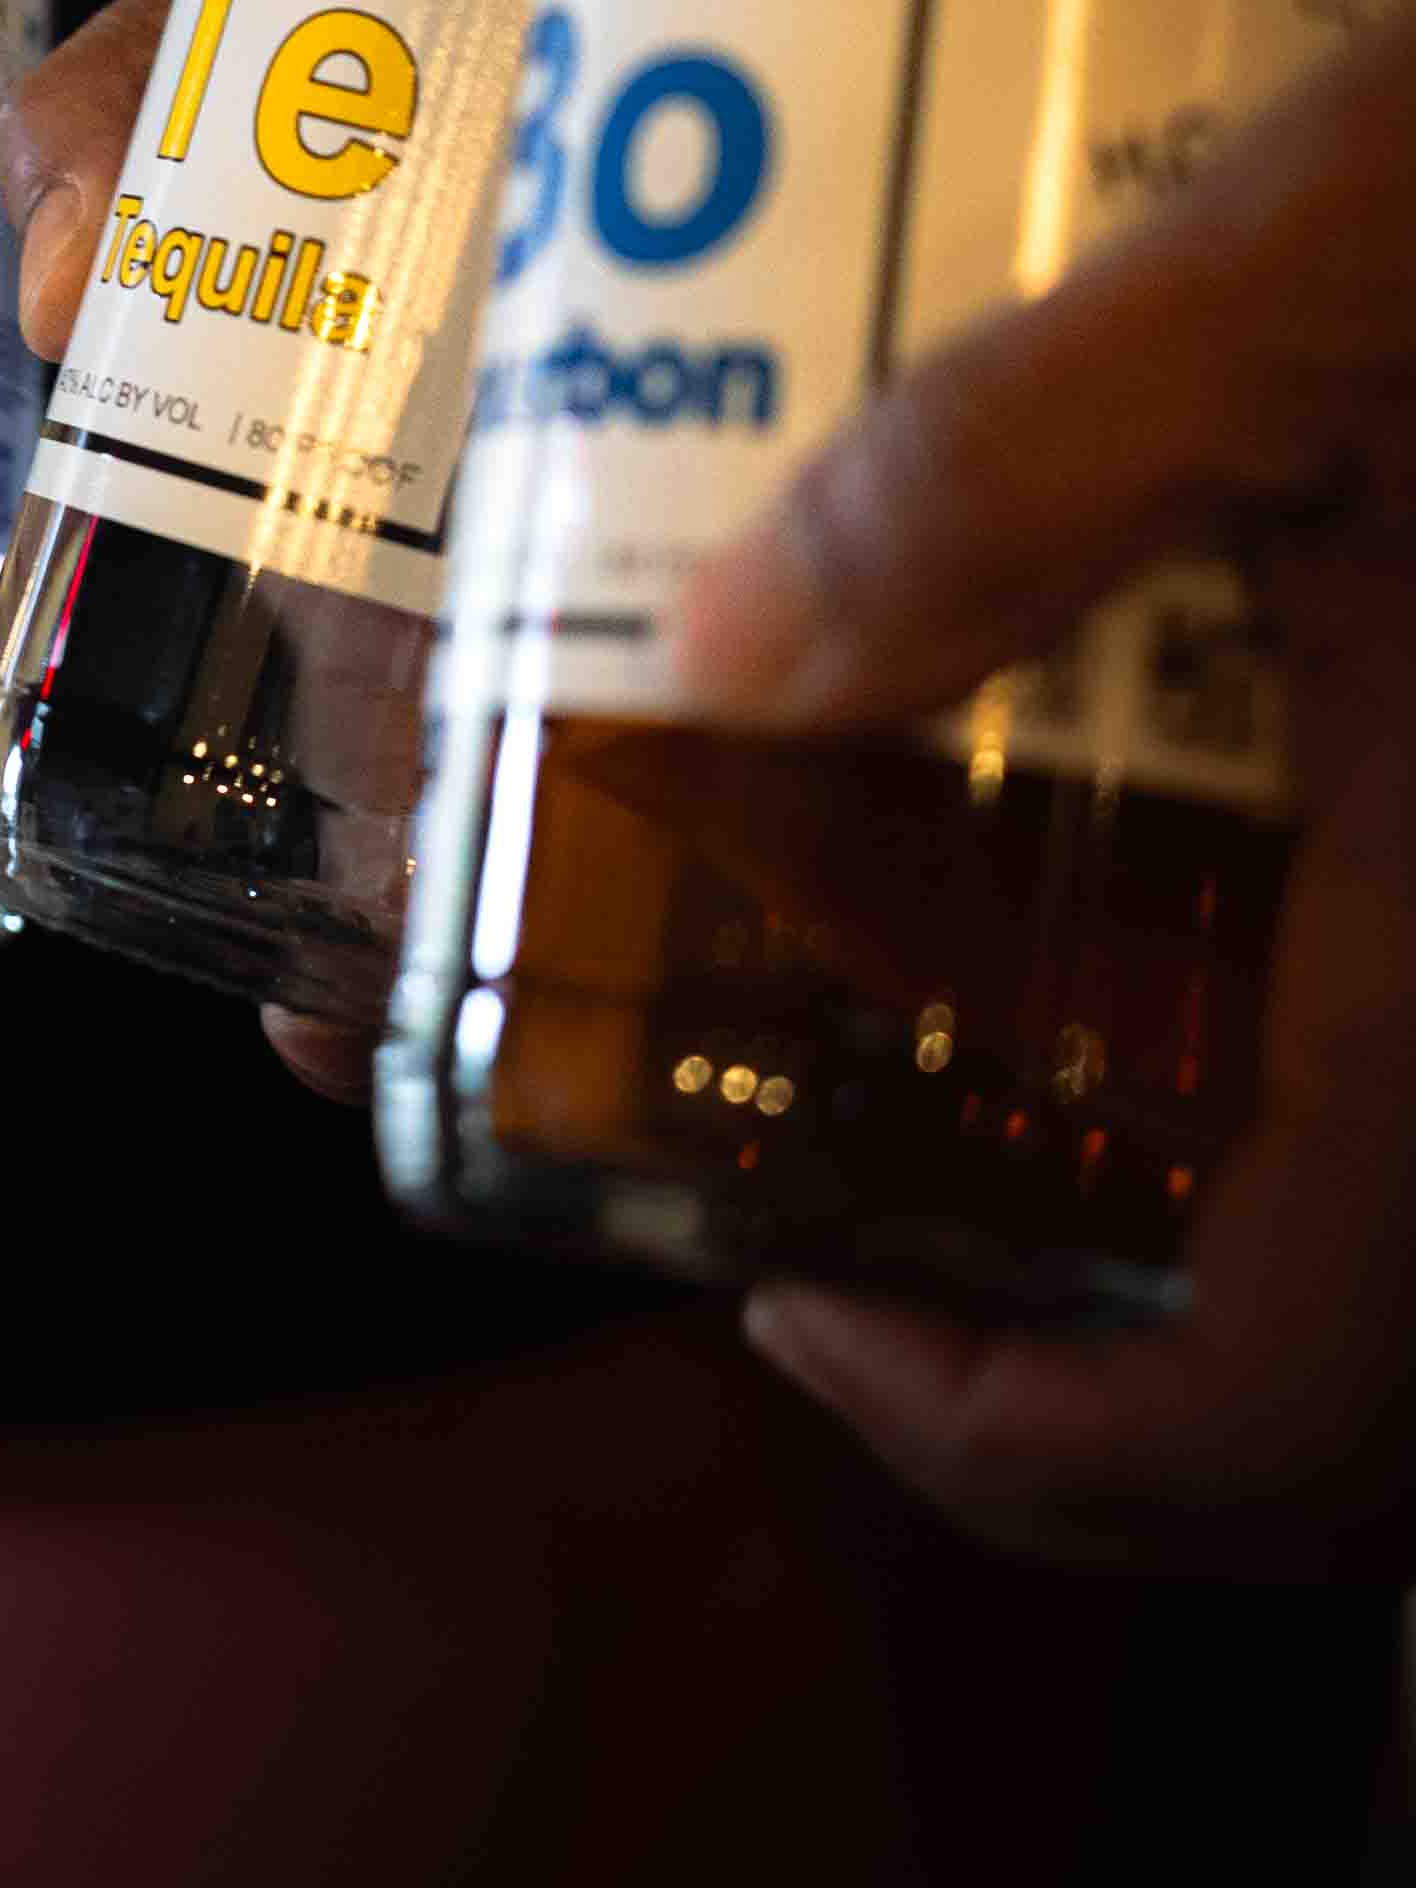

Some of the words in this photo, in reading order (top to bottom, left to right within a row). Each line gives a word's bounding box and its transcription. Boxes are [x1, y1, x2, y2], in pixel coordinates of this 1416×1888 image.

[100, 193, 381, 355] Tequila
[114, 380, 153, 414] BY
[151, 390, 202, 431] VOL
[246, 418, 286, 454] 80
